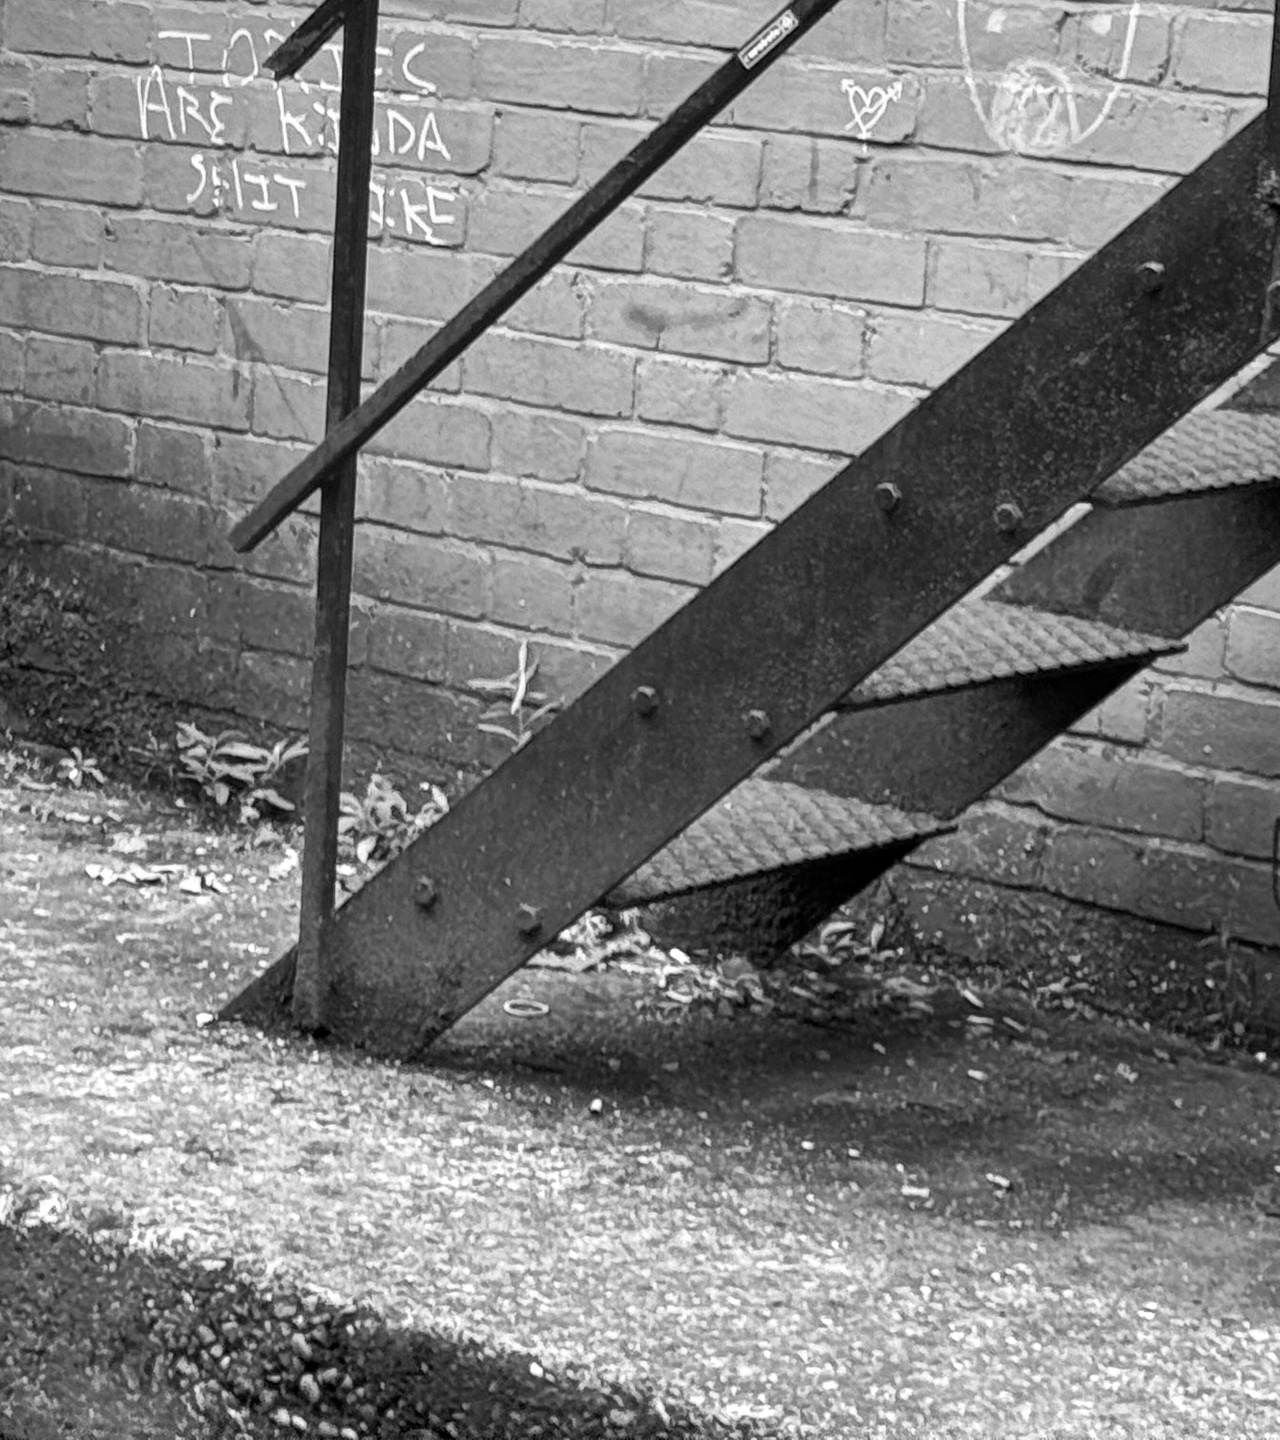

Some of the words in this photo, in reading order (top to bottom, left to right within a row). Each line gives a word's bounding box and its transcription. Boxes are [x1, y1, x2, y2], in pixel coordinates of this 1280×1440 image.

[136, 64, 234, 146] ARE
[276, 86, 452, 162] KIDA
[186, 153, 308, 219] SHIT
[369, 180, 456, 247] IKE
